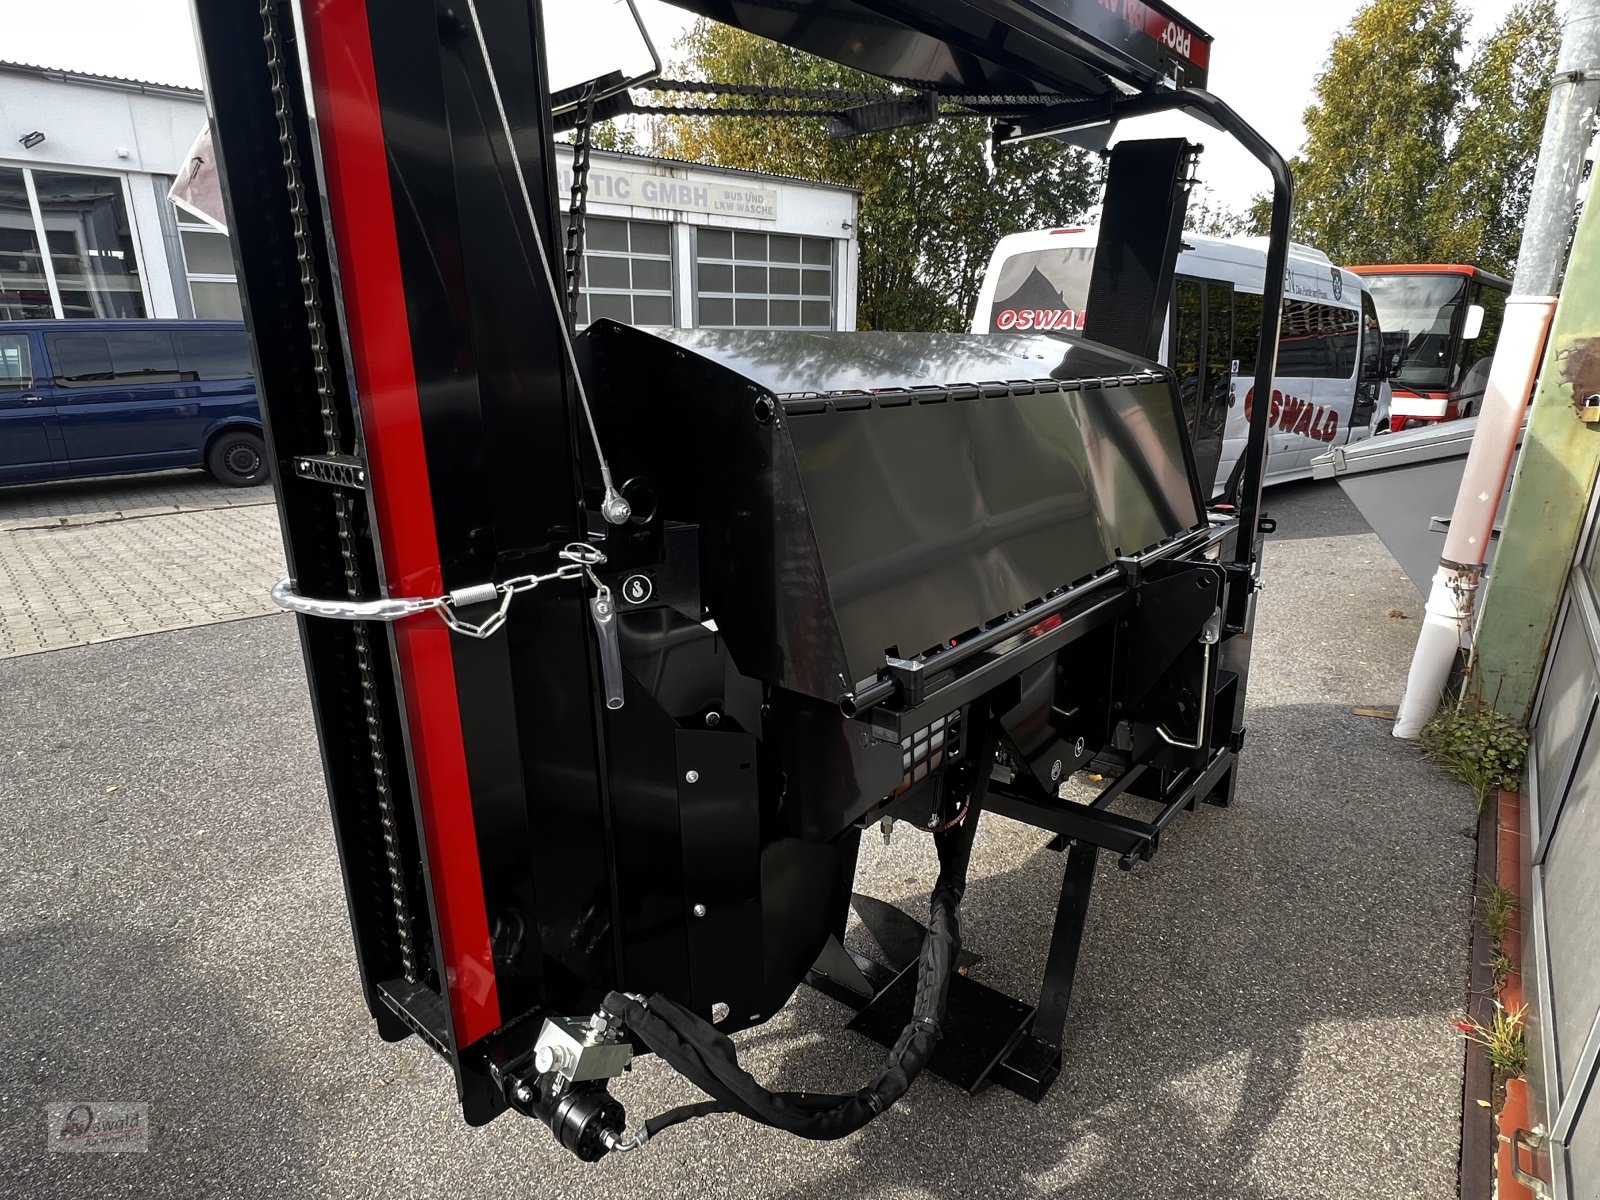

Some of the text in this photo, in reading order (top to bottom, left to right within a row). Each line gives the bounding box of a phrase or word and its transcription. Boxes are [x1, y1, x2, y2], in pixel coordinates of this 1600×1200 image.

[1162, 21, 1191, 58] PRO+
[641, 180, 709, 207] GMBH
[724, 191, 764, 203] BUS UND
[714, 200, 734, 211] LKW
